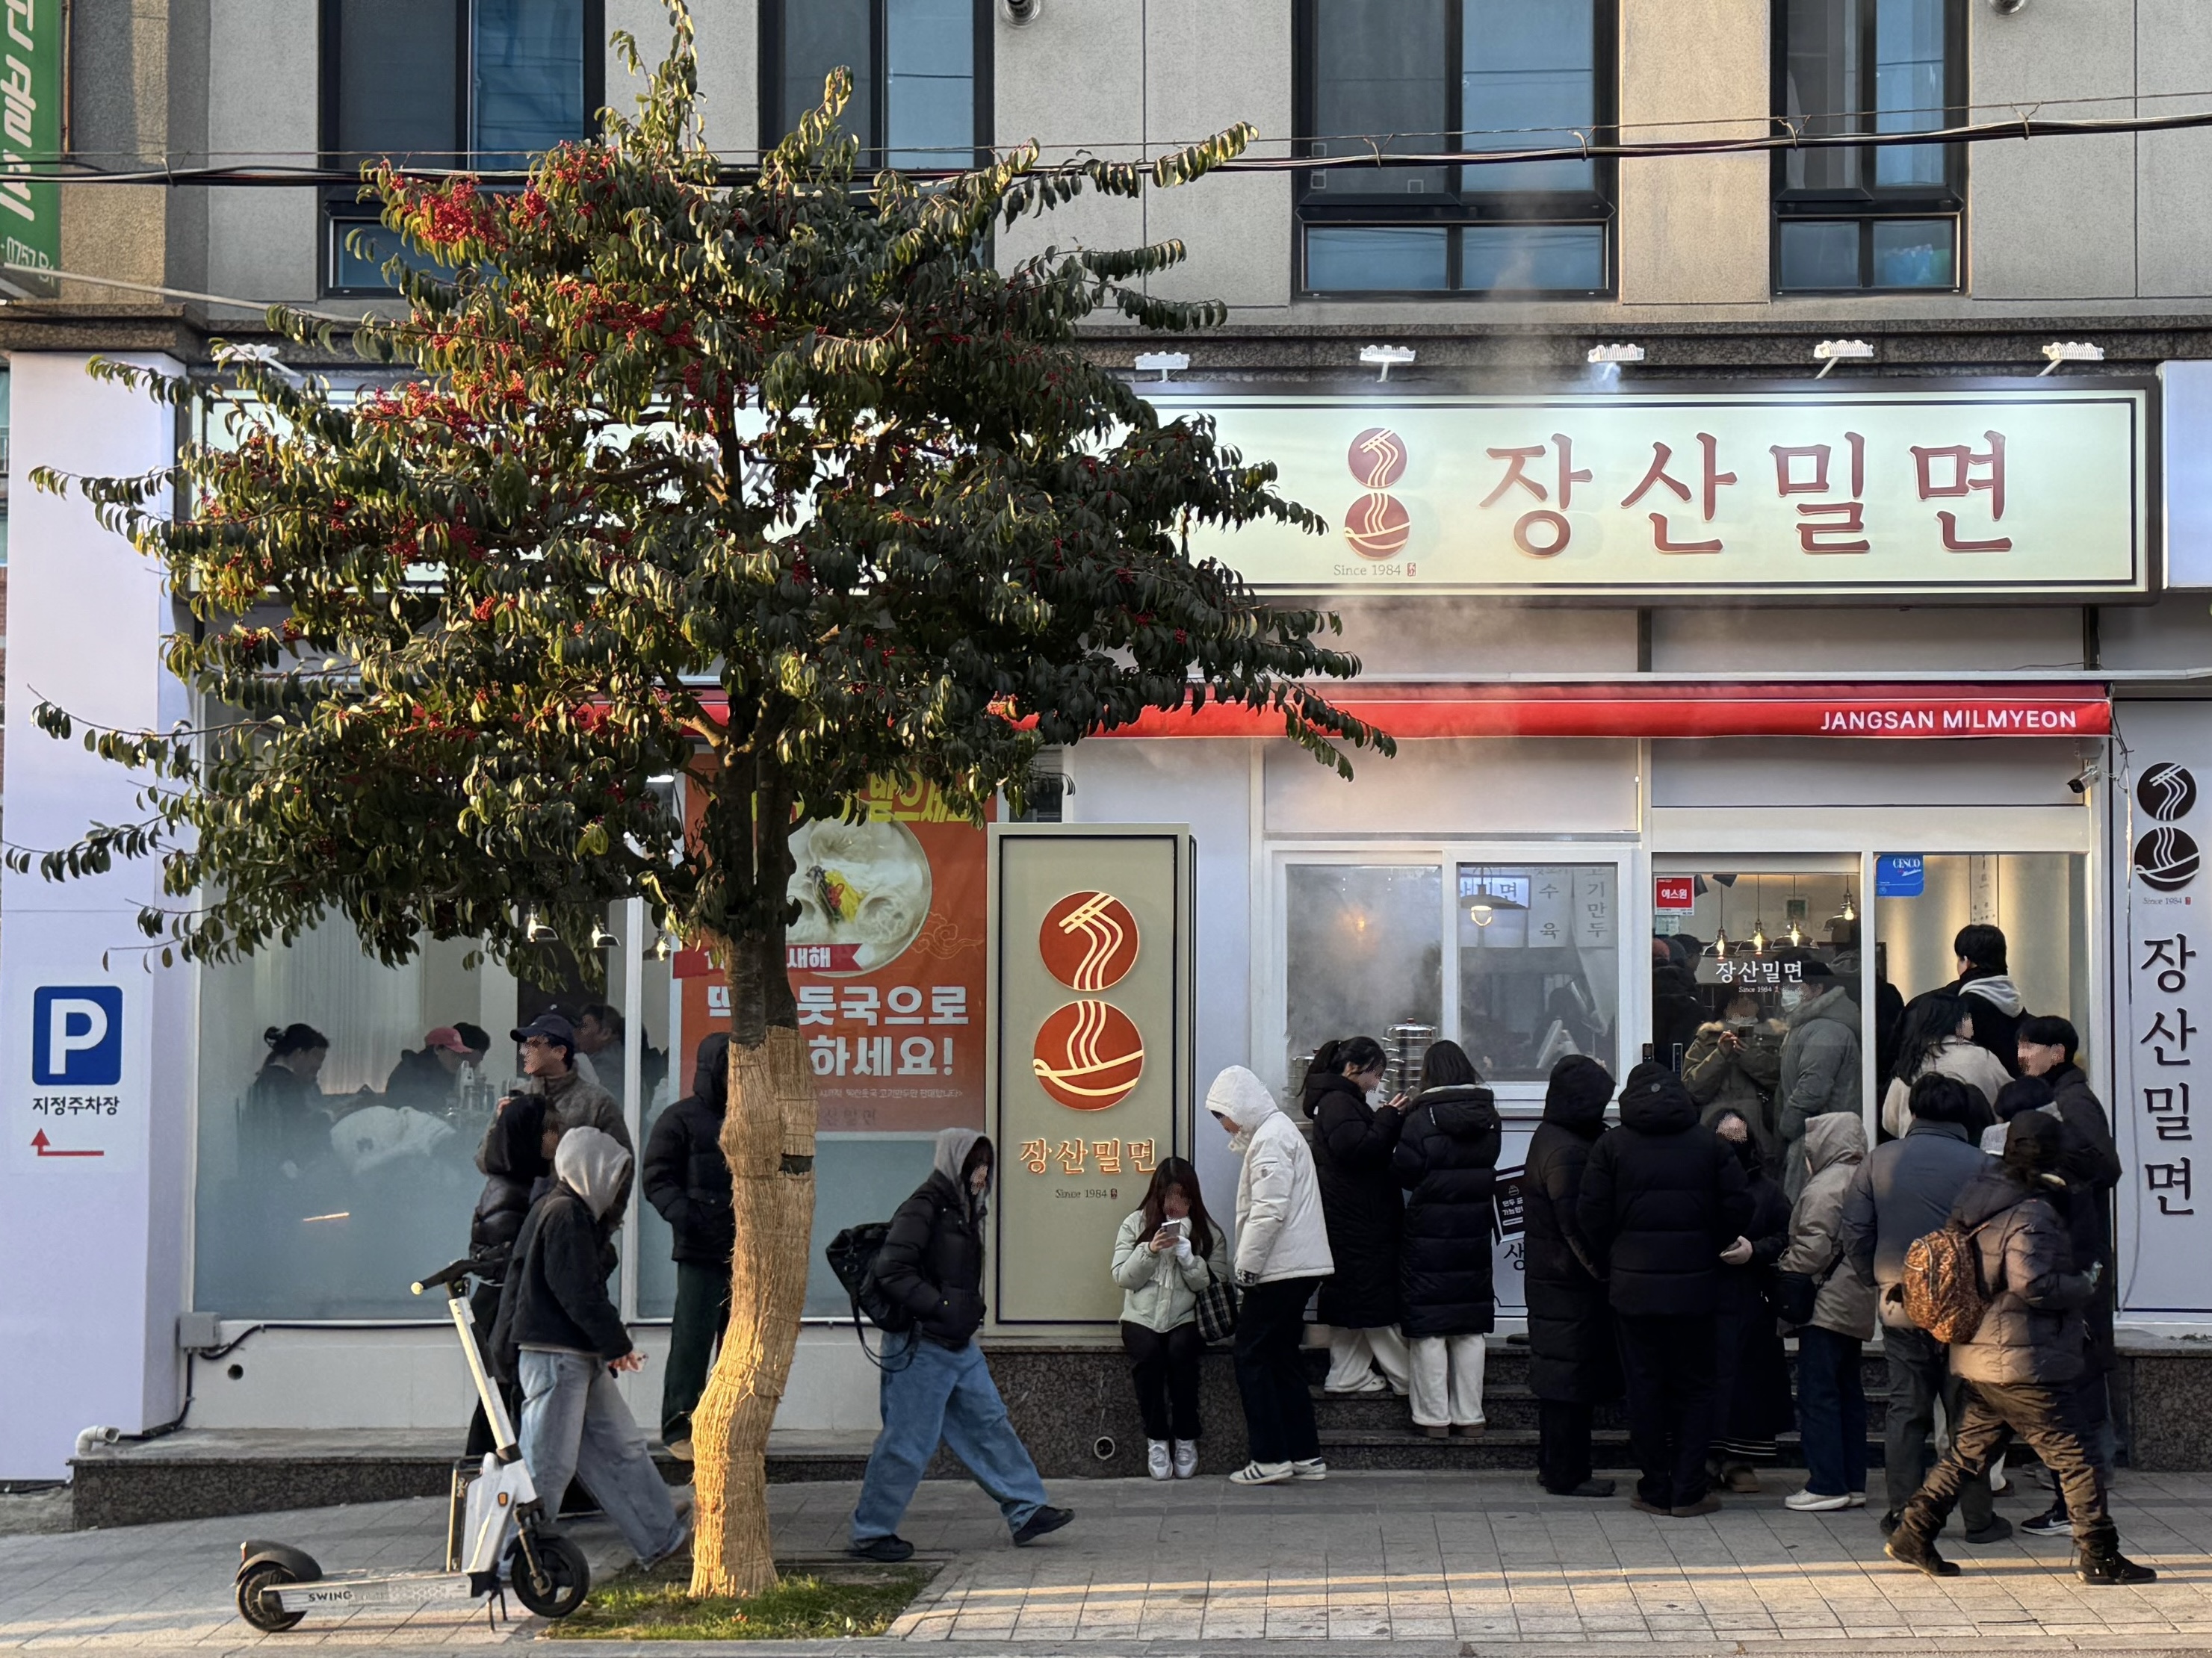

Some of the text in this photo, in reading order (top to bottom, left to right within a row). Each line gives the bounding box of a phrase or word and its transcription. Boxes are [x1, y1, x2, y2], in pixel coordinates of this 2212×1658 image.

[1479, 429, 2013, 558] 장산밀면
[1333, 565, 1367, 576] Since
[1372, 565, 1401, 576] 1984
[1821, 710, 2077, 730] JANGSAN MILMYEON
[1893, 858, 1921, 869] CESCO
[787, 947, 831, 968] 새해
[1716, 960, 1803, 984] 장산밀면
[1738, 985, 1756, 993] Since
[49, 999, 108, 1075] P
[2141, 933, 2197, 1216] 장산밀면
[33, 1096, 120, 1116] 지정주차장
[1019, 1137, 1157, 1175] 장산밀면
[1056, 1188, 1081, 1199] Since
[1085, 1188, 1107, 1199] 1984
[309, 1591, 353, 1602] SWING
